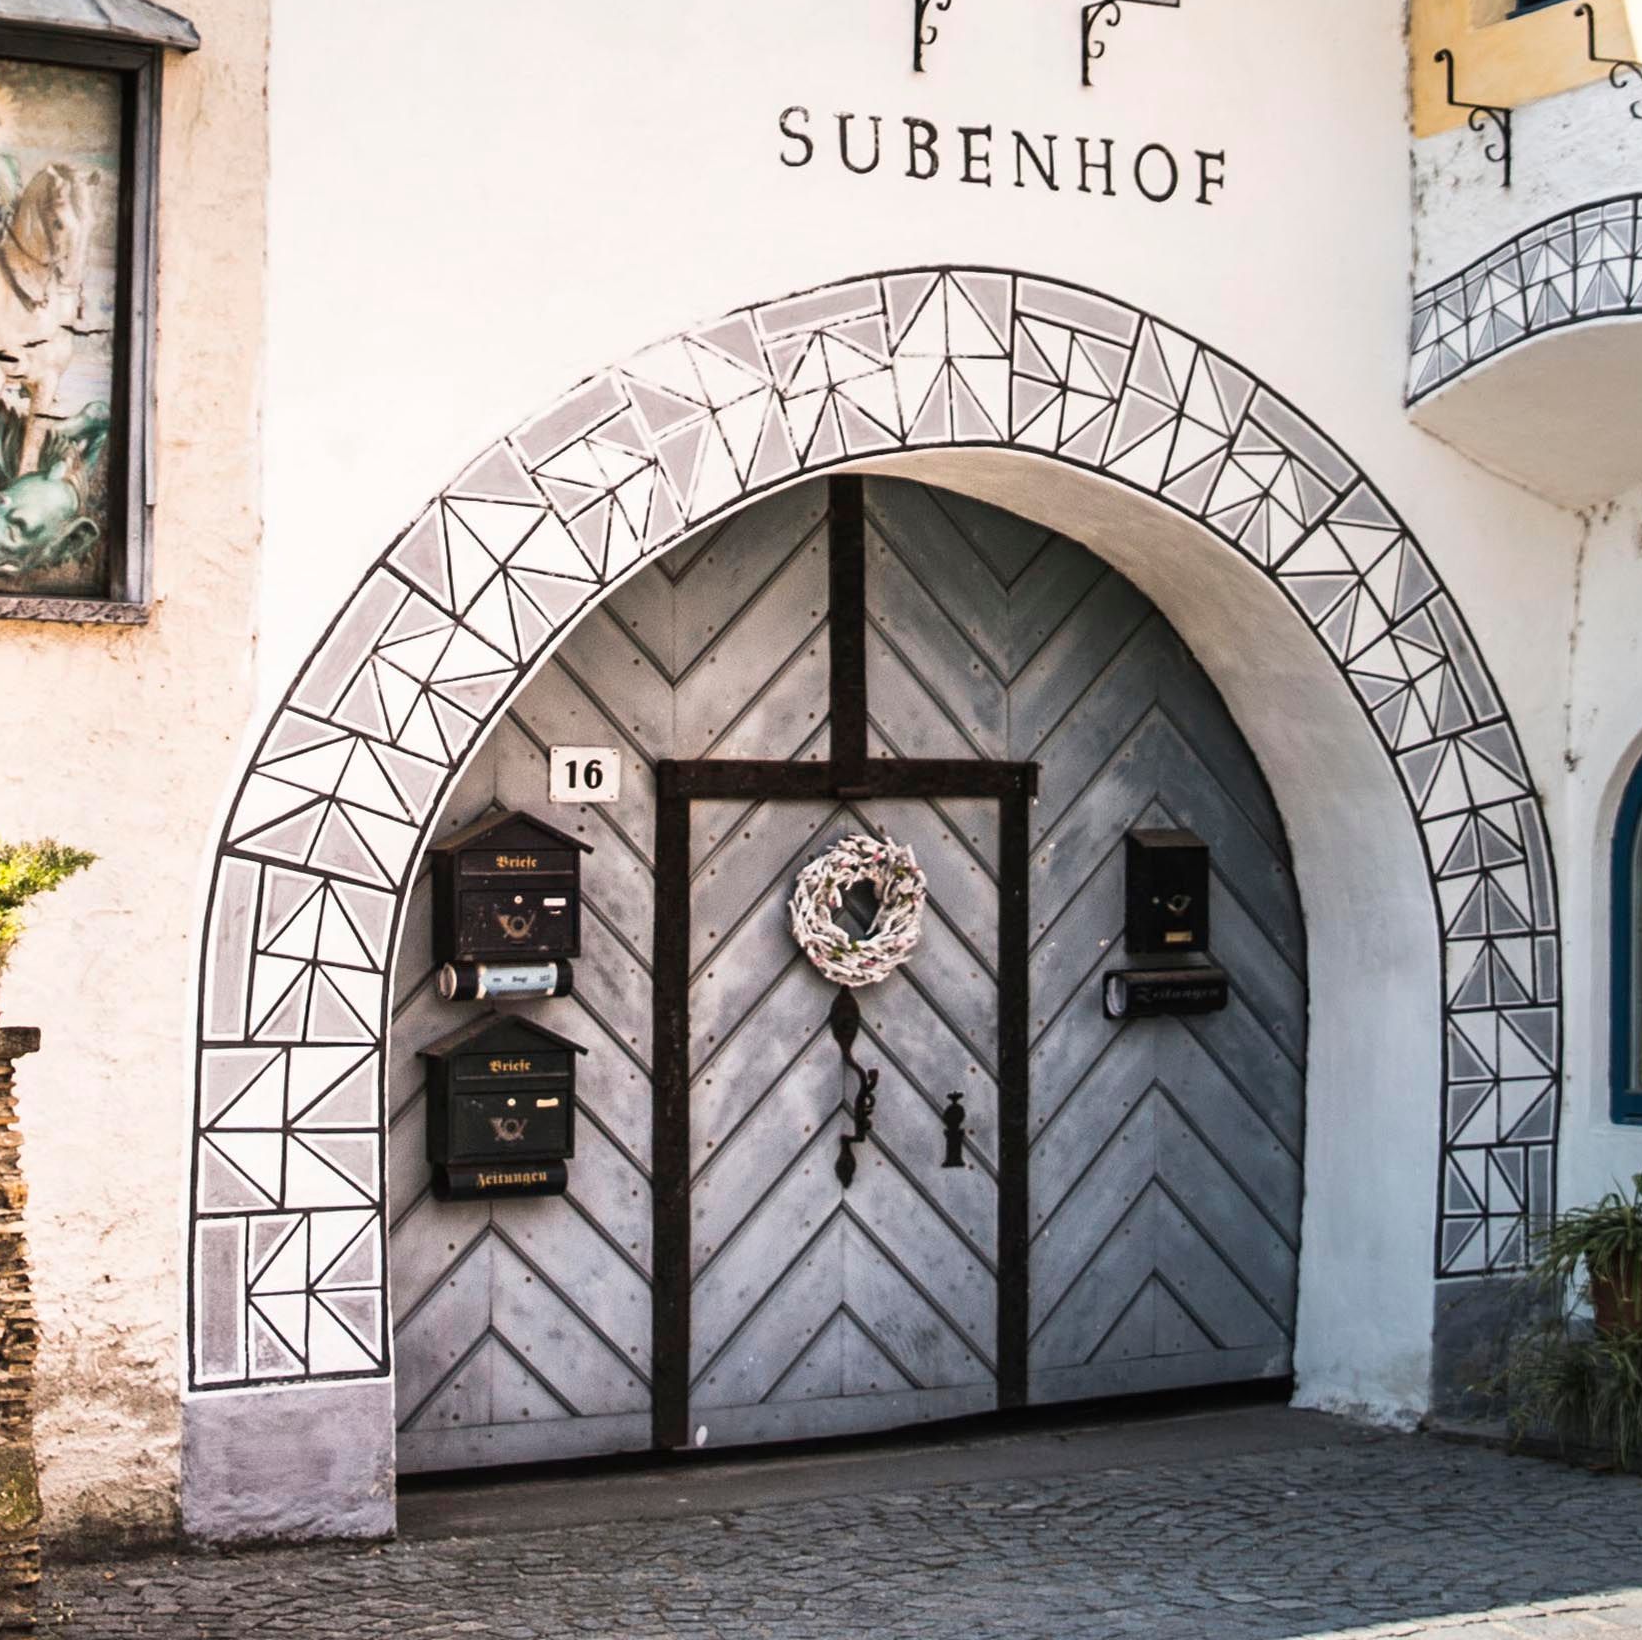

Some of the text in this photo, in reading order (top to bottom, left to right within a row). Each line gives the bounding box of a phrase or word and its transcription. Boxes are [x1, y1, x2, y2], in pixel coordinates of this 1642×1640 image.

[778, 104, 1227, 207] SUBENHOF
[564, 758, 604, 790] 16
[476, 1170, 548, 1190] Zeitungen
